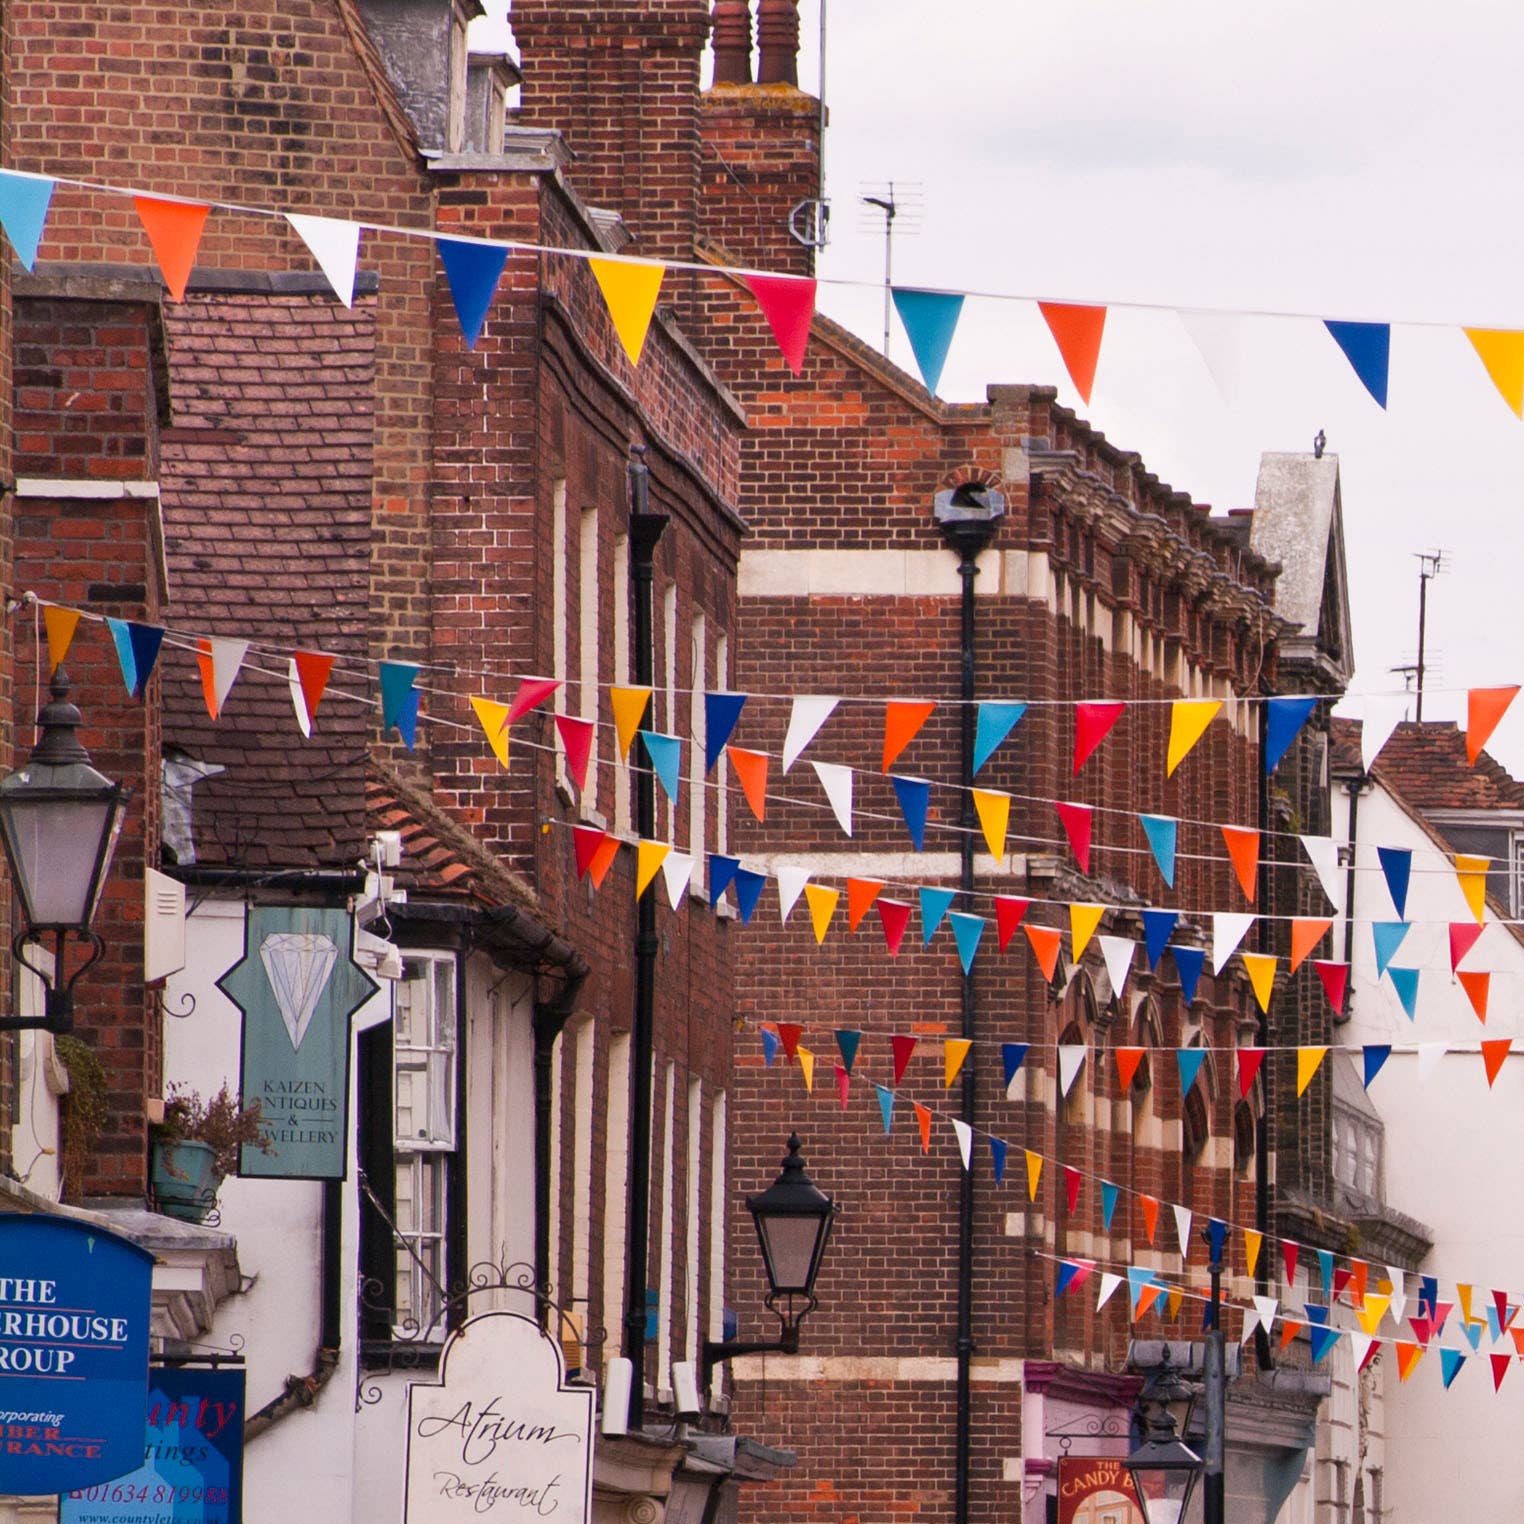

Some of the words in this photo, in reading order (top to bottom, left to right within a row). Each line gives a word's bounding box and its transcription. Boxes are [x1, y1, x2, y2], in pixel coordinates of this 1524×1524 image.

[264, 1080, 325, 1094] KAIZEN
[264, 1097, 337, 1111] NTIQUES
[288, 1114, 298, 1126] &
[264, 1130, 338, 1144] WELLERY
[0, 1312, 128, 1342] RHOUSE
[418, 1396, 581, 1465] Atrium
[0, 1441, 102, 1459] RANCE
[1098, 1461, 1121, 1470] THE
[1062, 1470, 1120, 1497] CANDY
[86, 1484, 148, 1503] 01634
[433, 1471, 562, 1516] Restaurant
